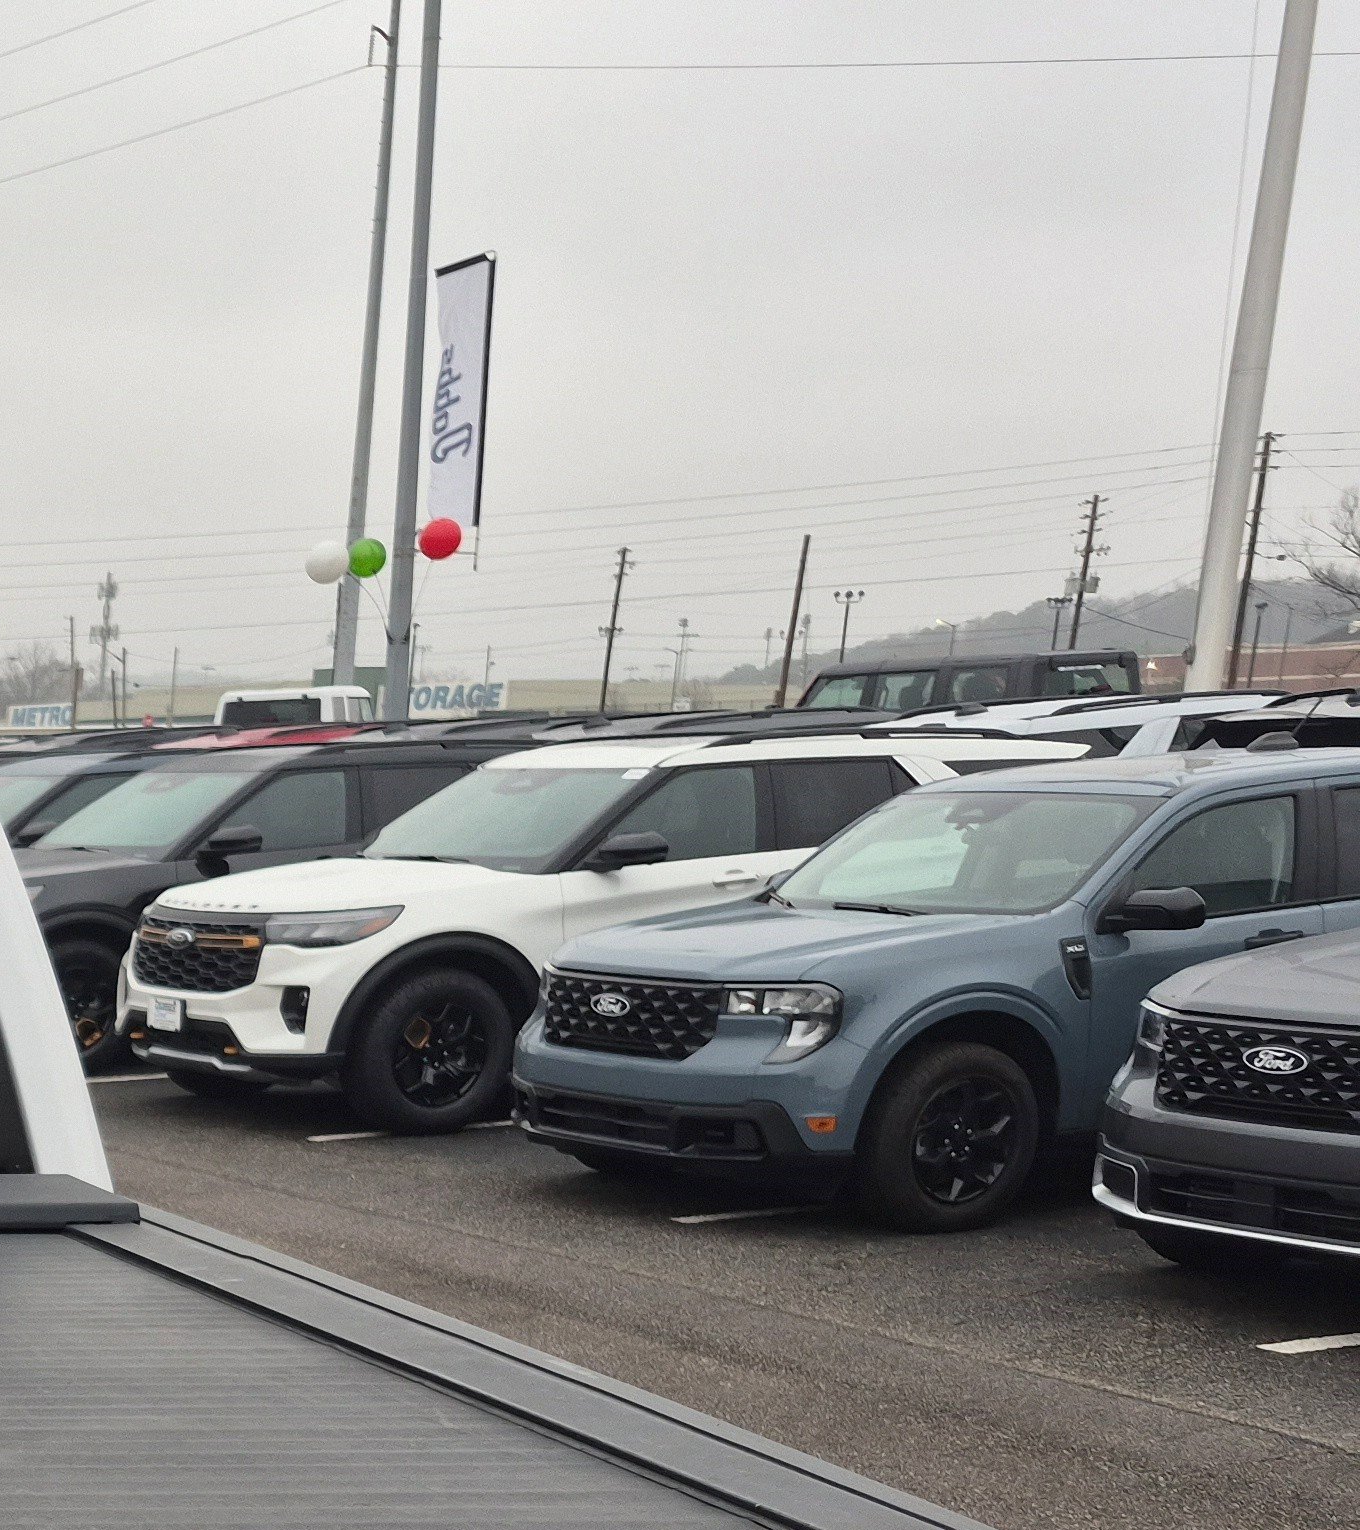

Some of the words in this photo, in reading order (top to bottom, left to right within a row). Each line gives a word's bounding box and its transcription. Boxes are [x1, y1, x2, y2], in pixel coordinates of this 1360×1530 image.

[430, 343, 472, 464] Dobbs
[409, 682, 504, 711] ORAGE
[11, 706, 73, 727] METRO
[1254, 1049, 1296, 1071] Ford
